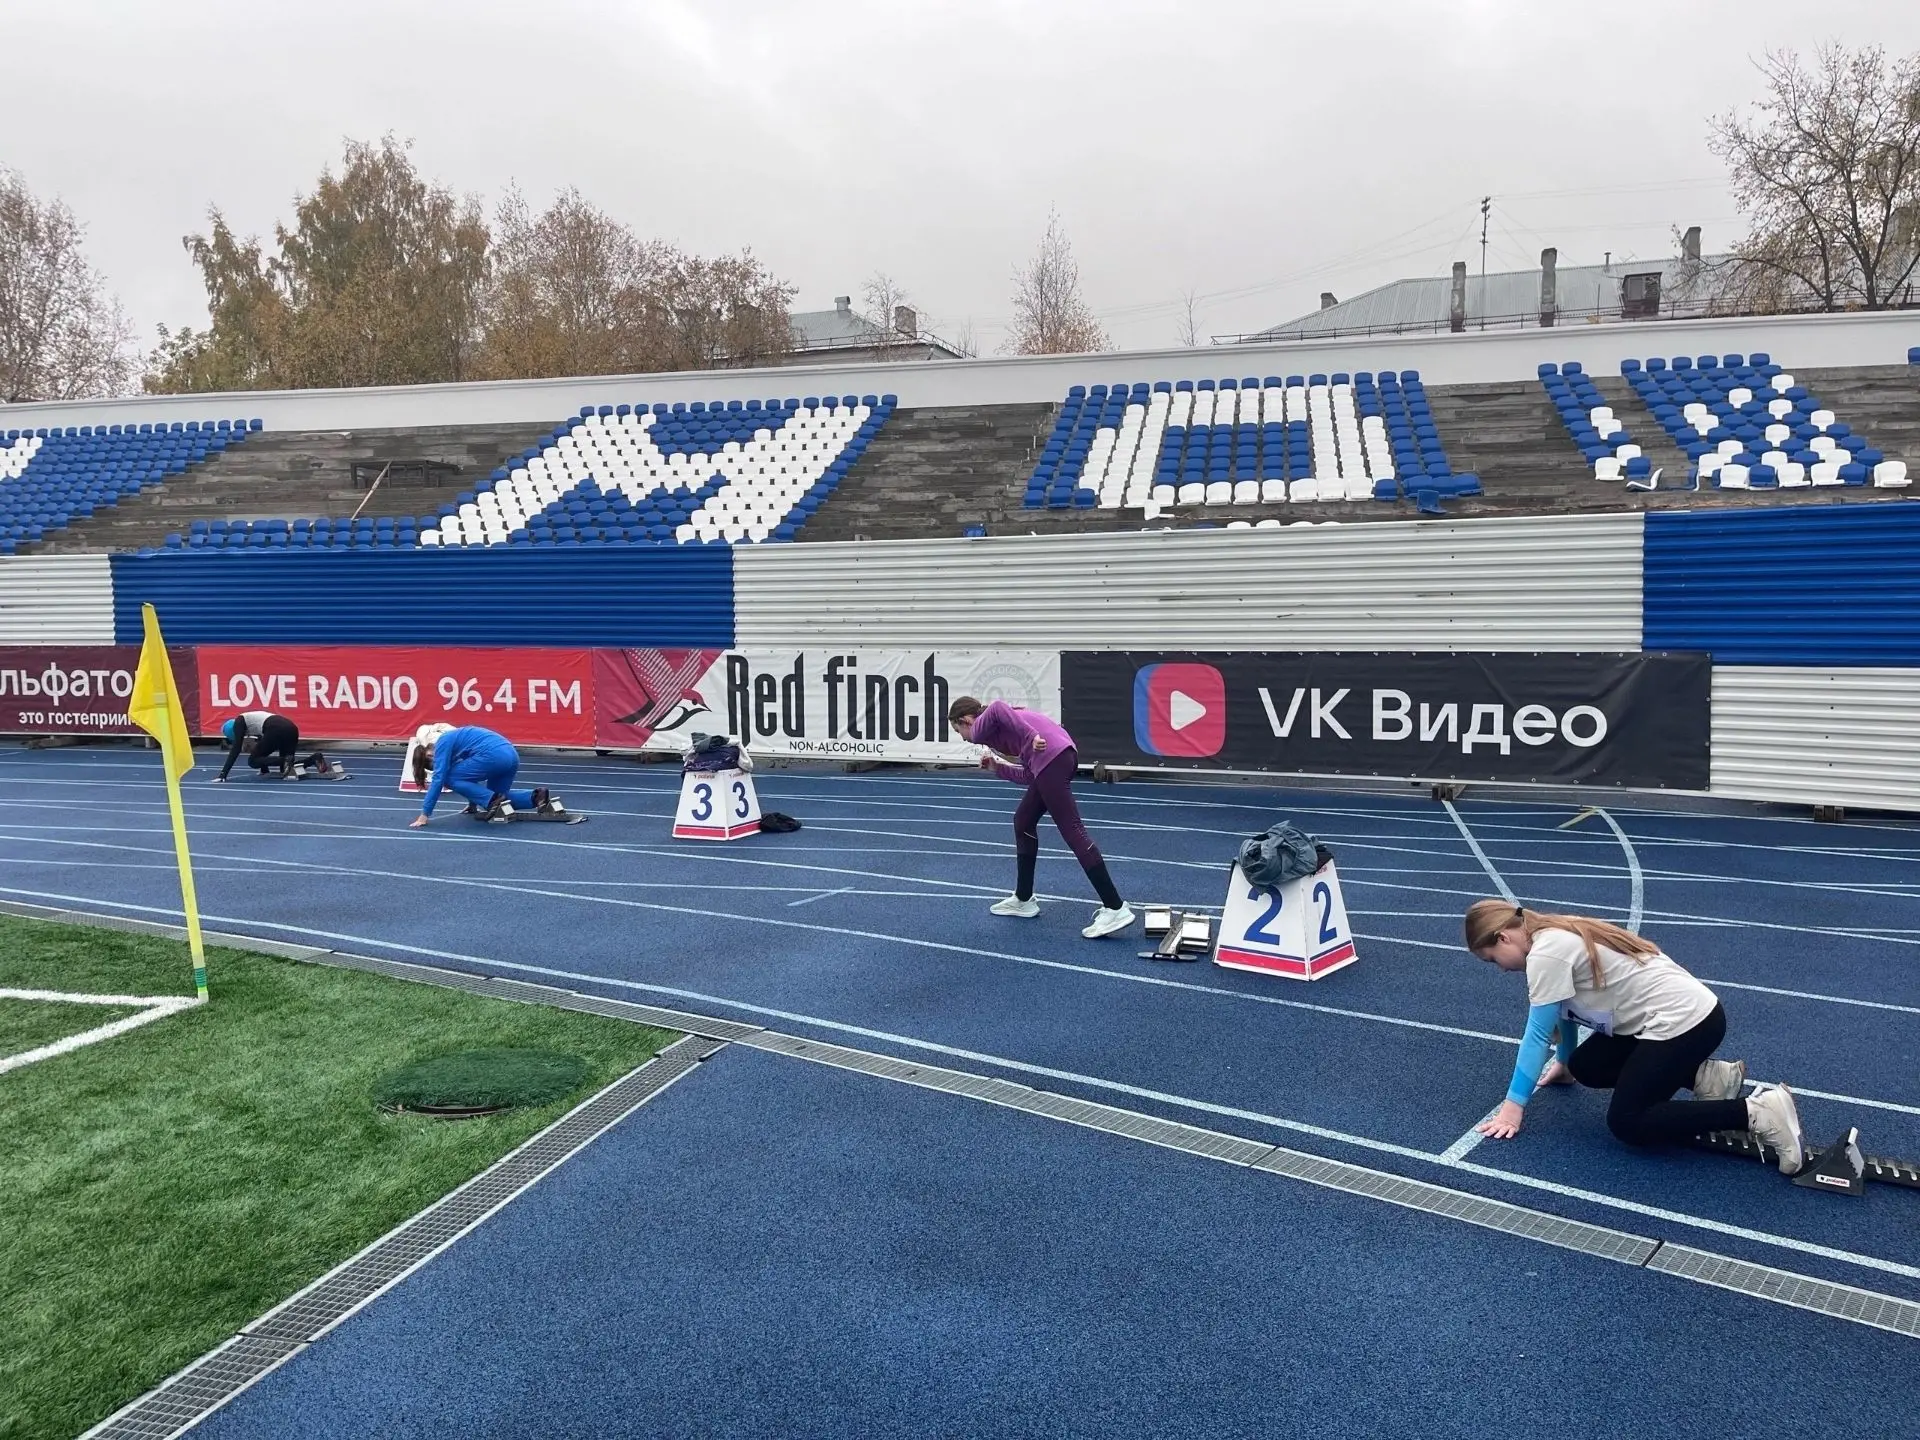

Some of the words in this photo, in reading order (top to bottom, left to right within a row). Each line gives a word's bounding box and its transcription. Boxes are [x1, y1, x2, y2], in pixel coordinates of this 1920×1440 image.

[0, 662, 138, 706] льфато
[210, 674, 298, 708] LOVE
[307, 675, 419, 711] RADIO
[438, 677, 517, 713] 96.4
[528, 679, 582, 715] FM
[727, 652, 805, 748] Red
[823, 652, 950, 743] finch
[18, 711, 44, 725] это
[1258, 687, 1353, 739] VK
[1372, 688, 1608, 755] Видео
[789, 741, 884, 753] NON-ALCOHOLIC
[691, 782, 713, 822] 3
[732, 781, 750, 819] 3
[1243, 884, 1283, 946] 2
[1312, 881, 1338, 945] 2
